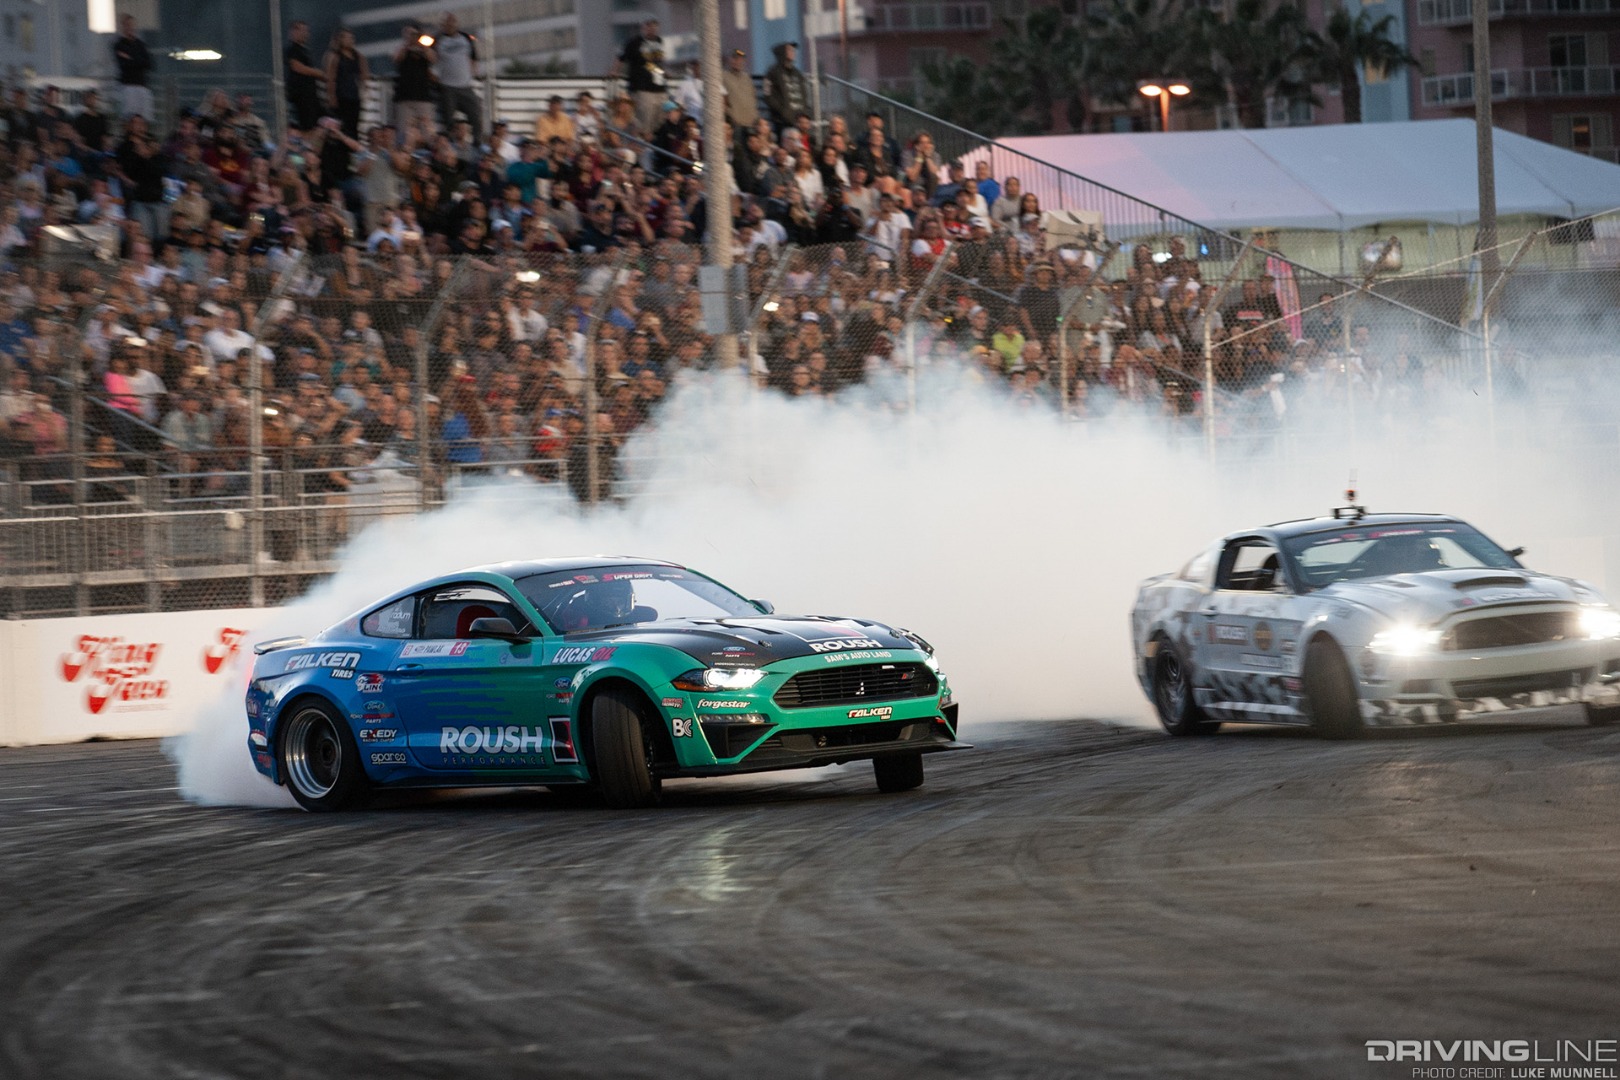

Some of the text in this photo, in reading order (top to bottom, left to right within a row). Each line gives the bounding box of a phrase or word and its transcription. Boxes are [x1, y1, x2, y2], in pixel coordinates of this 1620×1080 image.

[809, 639, 883, 653] ROUSH
[284, 652, 361, 671] FALKEN
[551, 647, 618, 664] LUCAS OIL
[824, 651, 892, 663] SAM'S AUTO LAND
[331, 669, 354, 678] TIRES
[697, 699, 750, 709] forgestar
[848, 706, 893, 718] FALKEN
[359, 729, 397, 739] EXEDY
[672, 719, 692, 737] BC
[440, 725, 543, 754] ROUSH
[371, 752, 406, 764] sparco
[443, 757, 545, 765] PERFORMANCE
